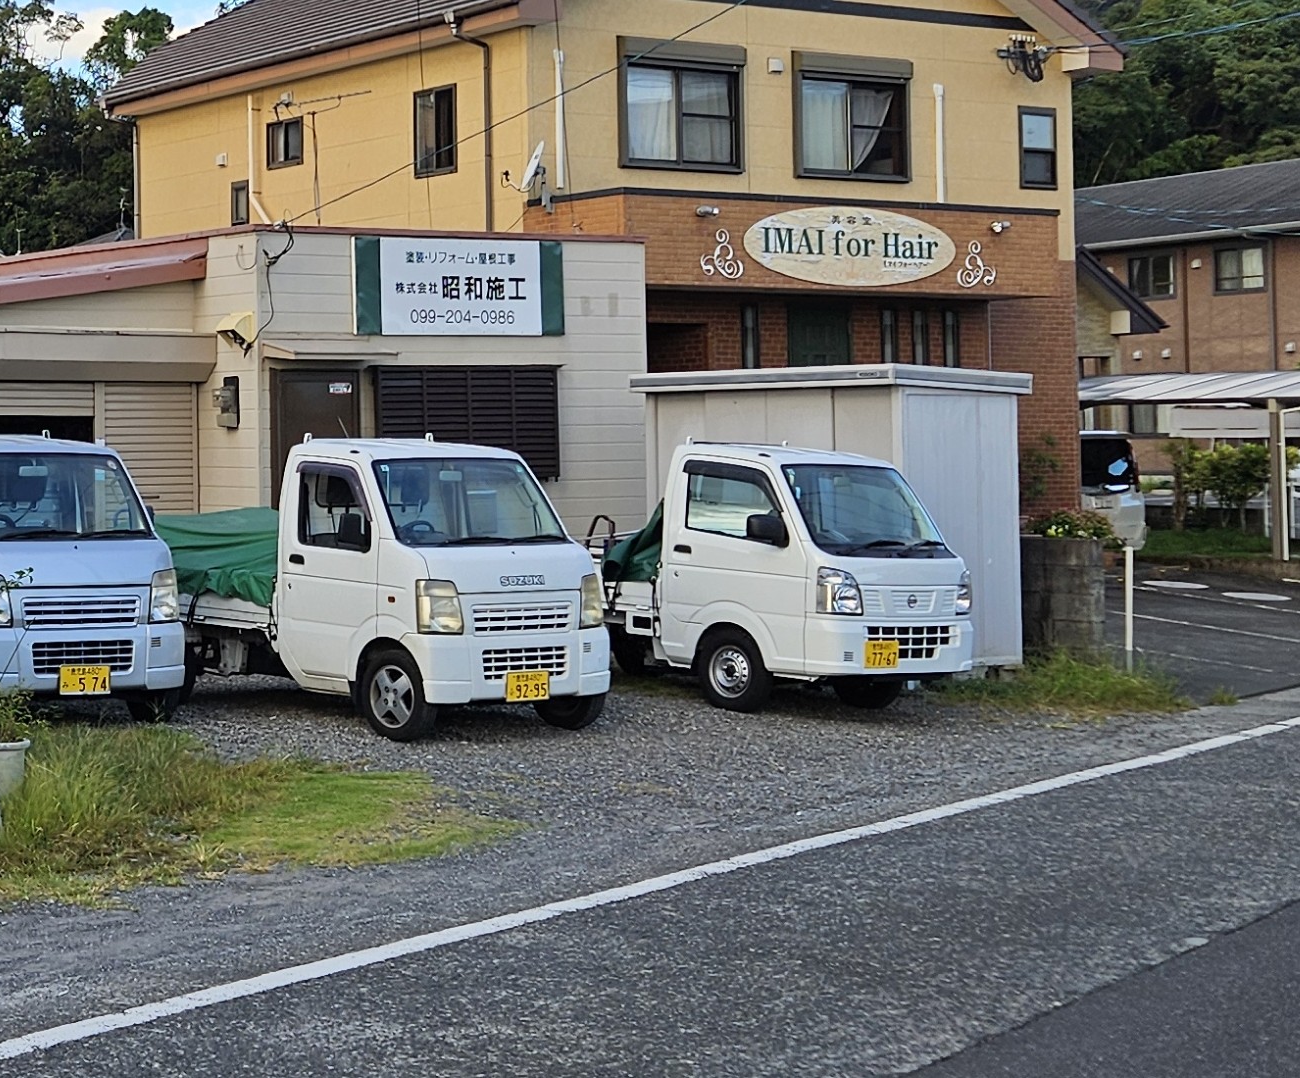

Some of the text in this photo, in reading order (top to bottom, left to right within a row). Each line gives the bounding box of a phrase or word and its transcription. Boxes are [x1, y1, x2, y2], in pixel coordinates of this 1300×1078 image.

[761, 227, 939, 260] IMAI for Hair
[395, 276, 527, 300] 株式会社 昭和施工
[410, 309, 515, 324] 099-204-0986
[500, 575, 545, 586] SUZUKI
[515, 683, 547, 699] 92-95
